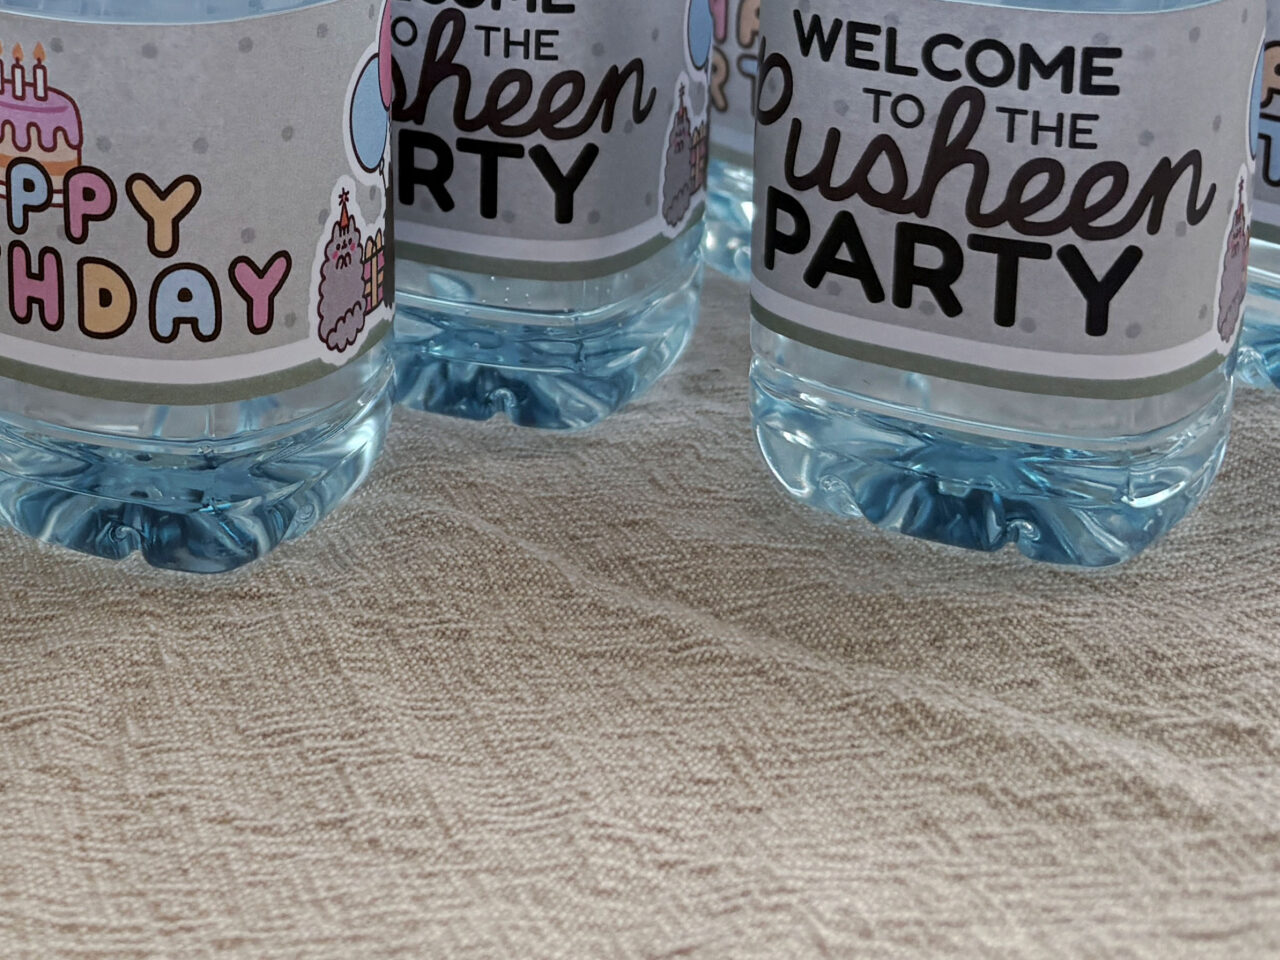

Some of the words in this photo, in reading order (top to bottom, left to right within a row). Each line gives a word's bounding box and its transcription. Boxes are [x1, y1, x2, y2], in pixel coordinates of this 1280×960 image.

[474, 24, 559, 60] THE
[793, 8, 1123, 96] WELCOME
[863, 87, 925, 128] TO
[995, 106, 1100, 149] THE
[763, 185, 1144, 336] PARTY
